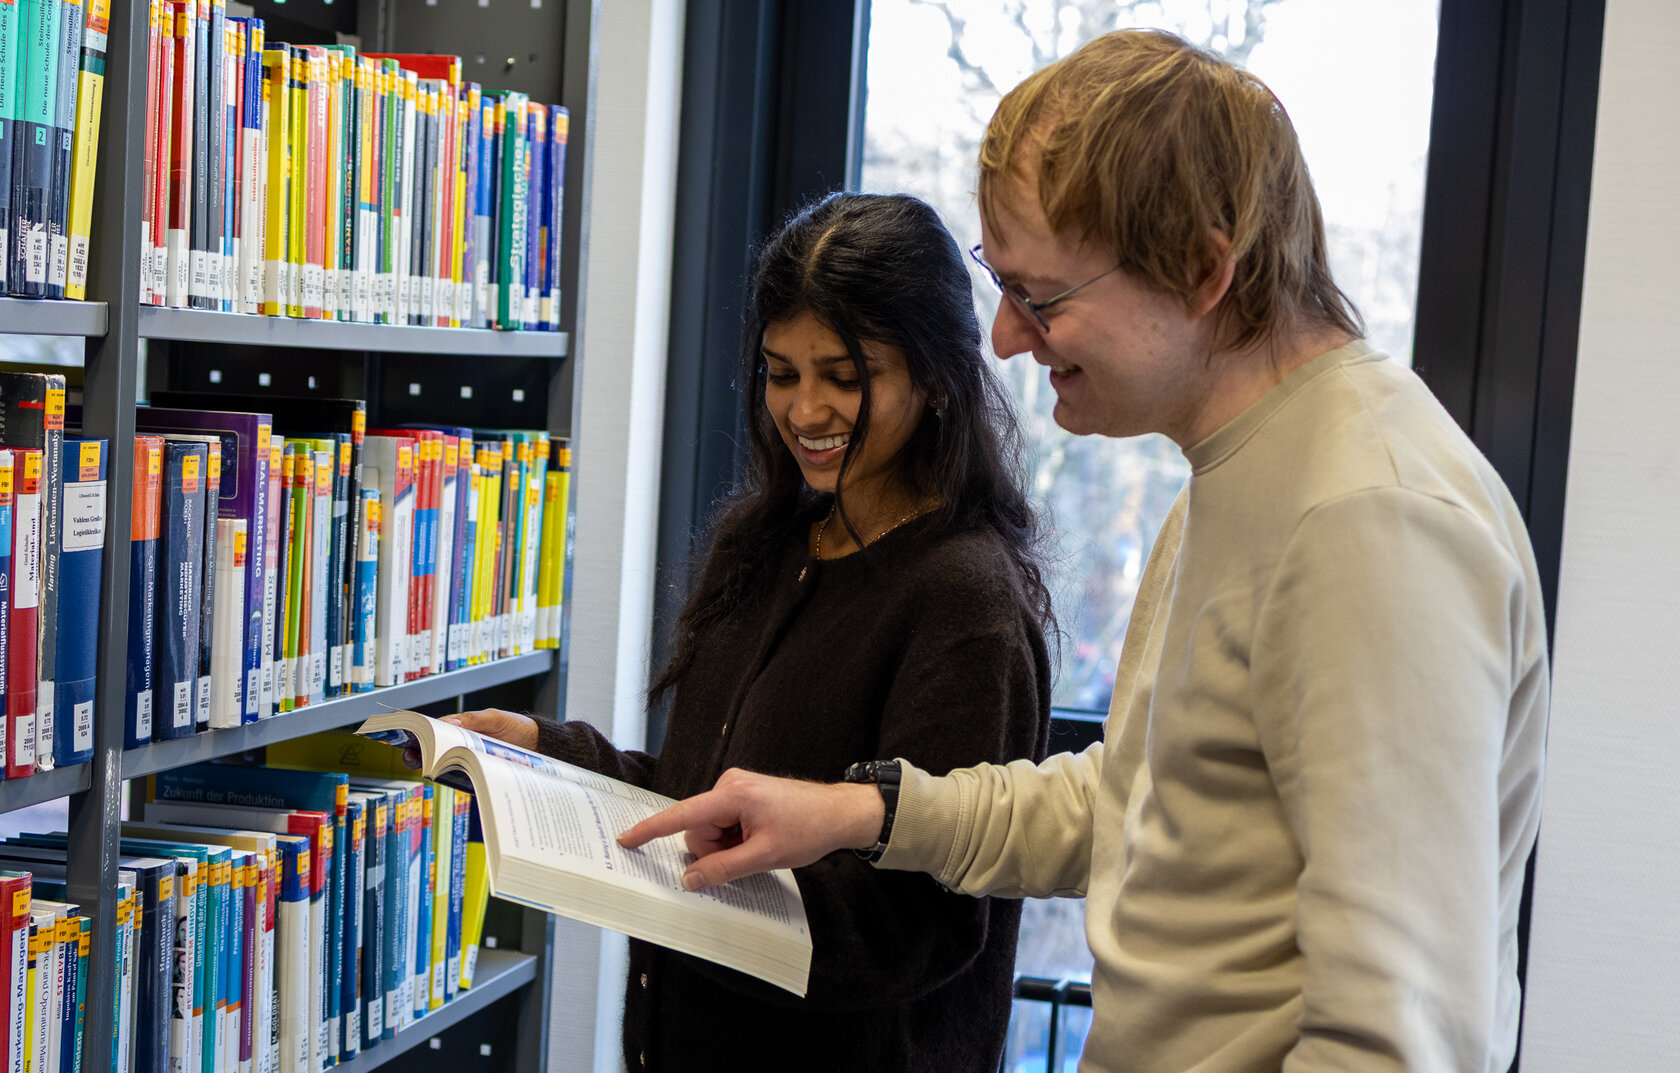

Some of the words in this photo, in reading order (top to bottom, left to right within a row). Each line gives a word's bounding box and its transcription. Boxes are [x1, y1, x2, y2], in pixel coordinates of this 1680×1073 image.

[66, 8, 74, 54] Steinmüller
[38, 130, 44, 142] 2
[509, 136, 523, 268] Strategisches
[255, 492, 265, 578] MARKETING
[48, 554, 57, 592] Harting
[265, 575, 275, 656] Marketing
[163, 785, 203, 801] Zukunft
[206, 789, 224, 802] der
[226, 791, 285, 808] Produktion
[159, 914, 167, 972] Handbuch
[195, 922, 205, 968] Umsetzung
[14, 928, 26, 1073] Marketing-Managem
[42, 971, 51, 990] and
[39, 990, 49, 1045] Operations
